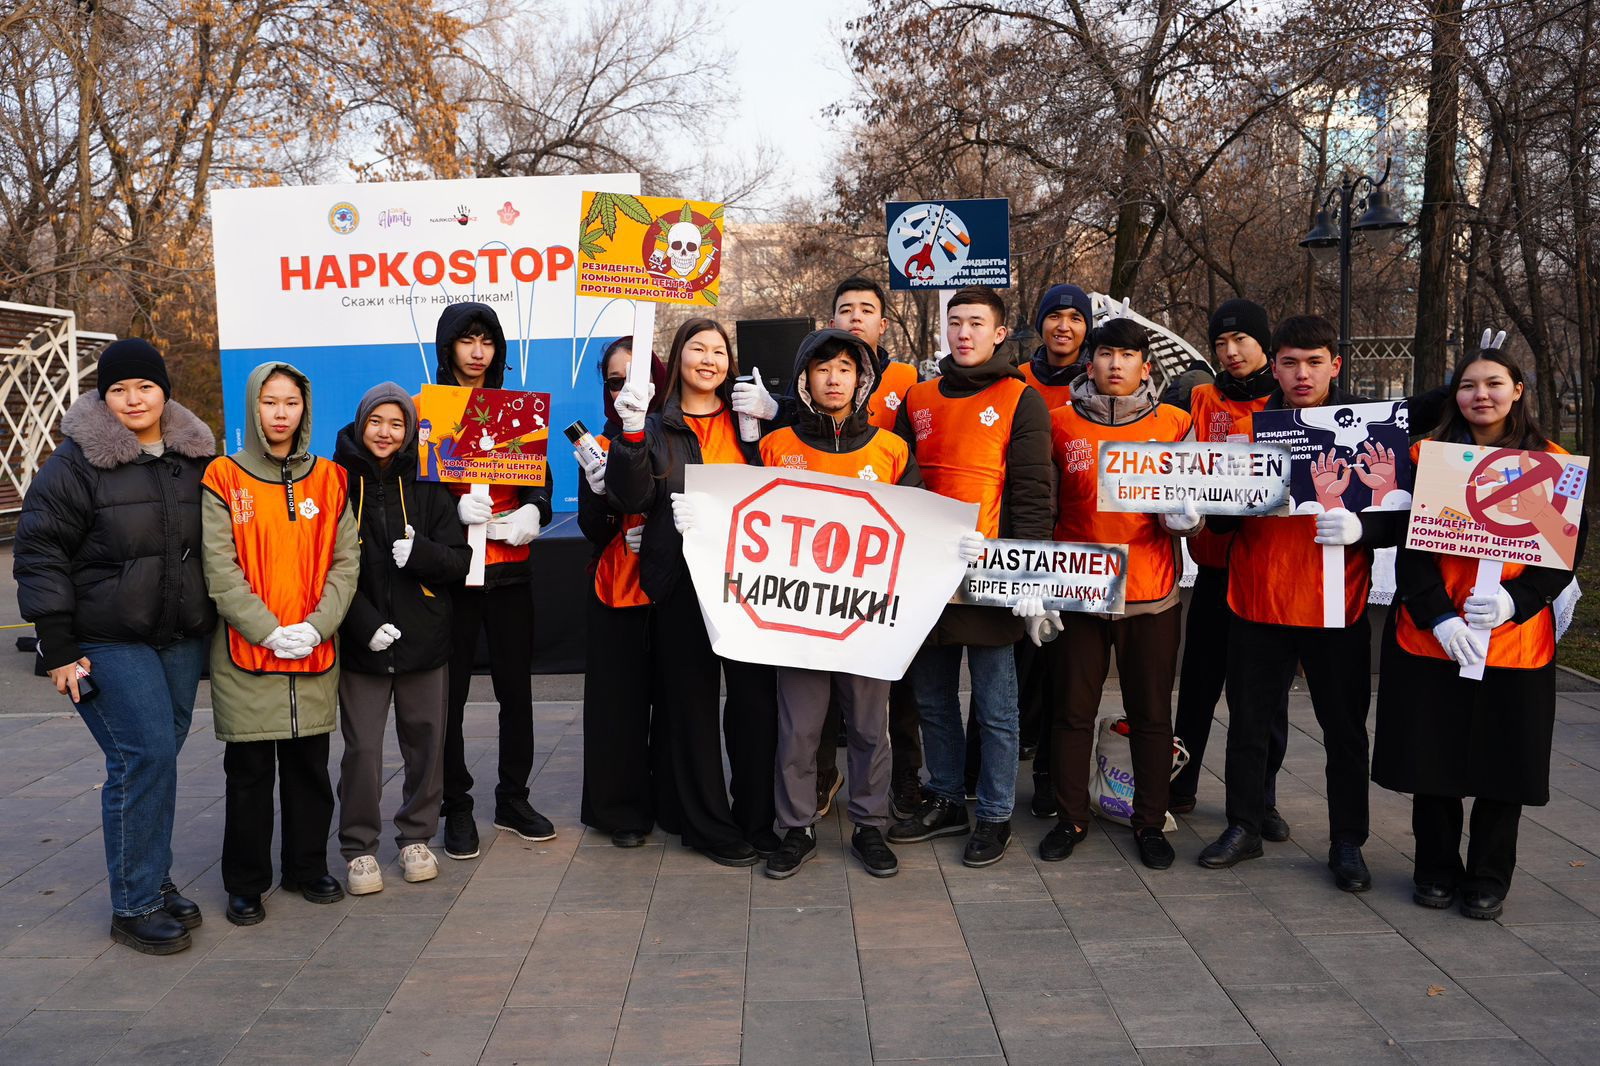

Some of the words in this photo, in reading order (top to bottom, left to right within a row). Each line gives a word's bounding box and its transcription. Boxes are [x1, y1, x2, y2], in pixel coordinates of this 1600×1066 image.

[378, 207, 412, 228] Almaty
[582, 262, 645, 274] РЕЗИДЕНТЫ
[971, 268, 1007, 277] ЦЕНТРА
[581, 273, 649, 286] КОМЬЮНИТИ
[651, 278, 693, 290] ЦЕНТРА
[946, 277, 1008, 286] НАРКОТИКОВ
[341, 296, 385, 308] Скажи
[431, 291, 514, 305] наркотикам!
[580, 284, 622, 295] ПРОТИВ
[624, 287, 694, 300] НАРКОТИКОВ
[1256, 429, 1305, 438] РЕЗИДЕНТЫ
[1290, 444, 1323, 453] ПРОТИВ
[487, 452, 544, 462] РЕЗИДЕНТЫ
[1105, 450, 1283, 477] ZHASTARMEN
[443, 460, 505, 470] КОМЬЮНИТИ
[506, 463, 542, 471] ЦЕНТРА
[440, 469, 478, 479] ПРОТИВ
[480, 472, 542, 481] НАРКОТИКОВ
[287, 480, 295, 512] FASHION
[1118, 486, 1160, 500] БІРГЕ
[1413, 515, 1486, 531] РЕЗИДЕНТЫ
[741, 510, 890, 578] STOP
[1411, 526, 1489, 544] КОМЬЮНИТИ
[1491, 538, 1541, 551] ЦЕНТРА
[1409, 538, 1456, 551] ПРОТИВ
[1459, 545, 1542, 563] НАРКОТИКОВ
[967, 547, 1121, 577] HASTARMEN
[968, 579, 1007, 595] БІРГЕ
[723, 572, 900, 628] НАРКОТИКИ!
